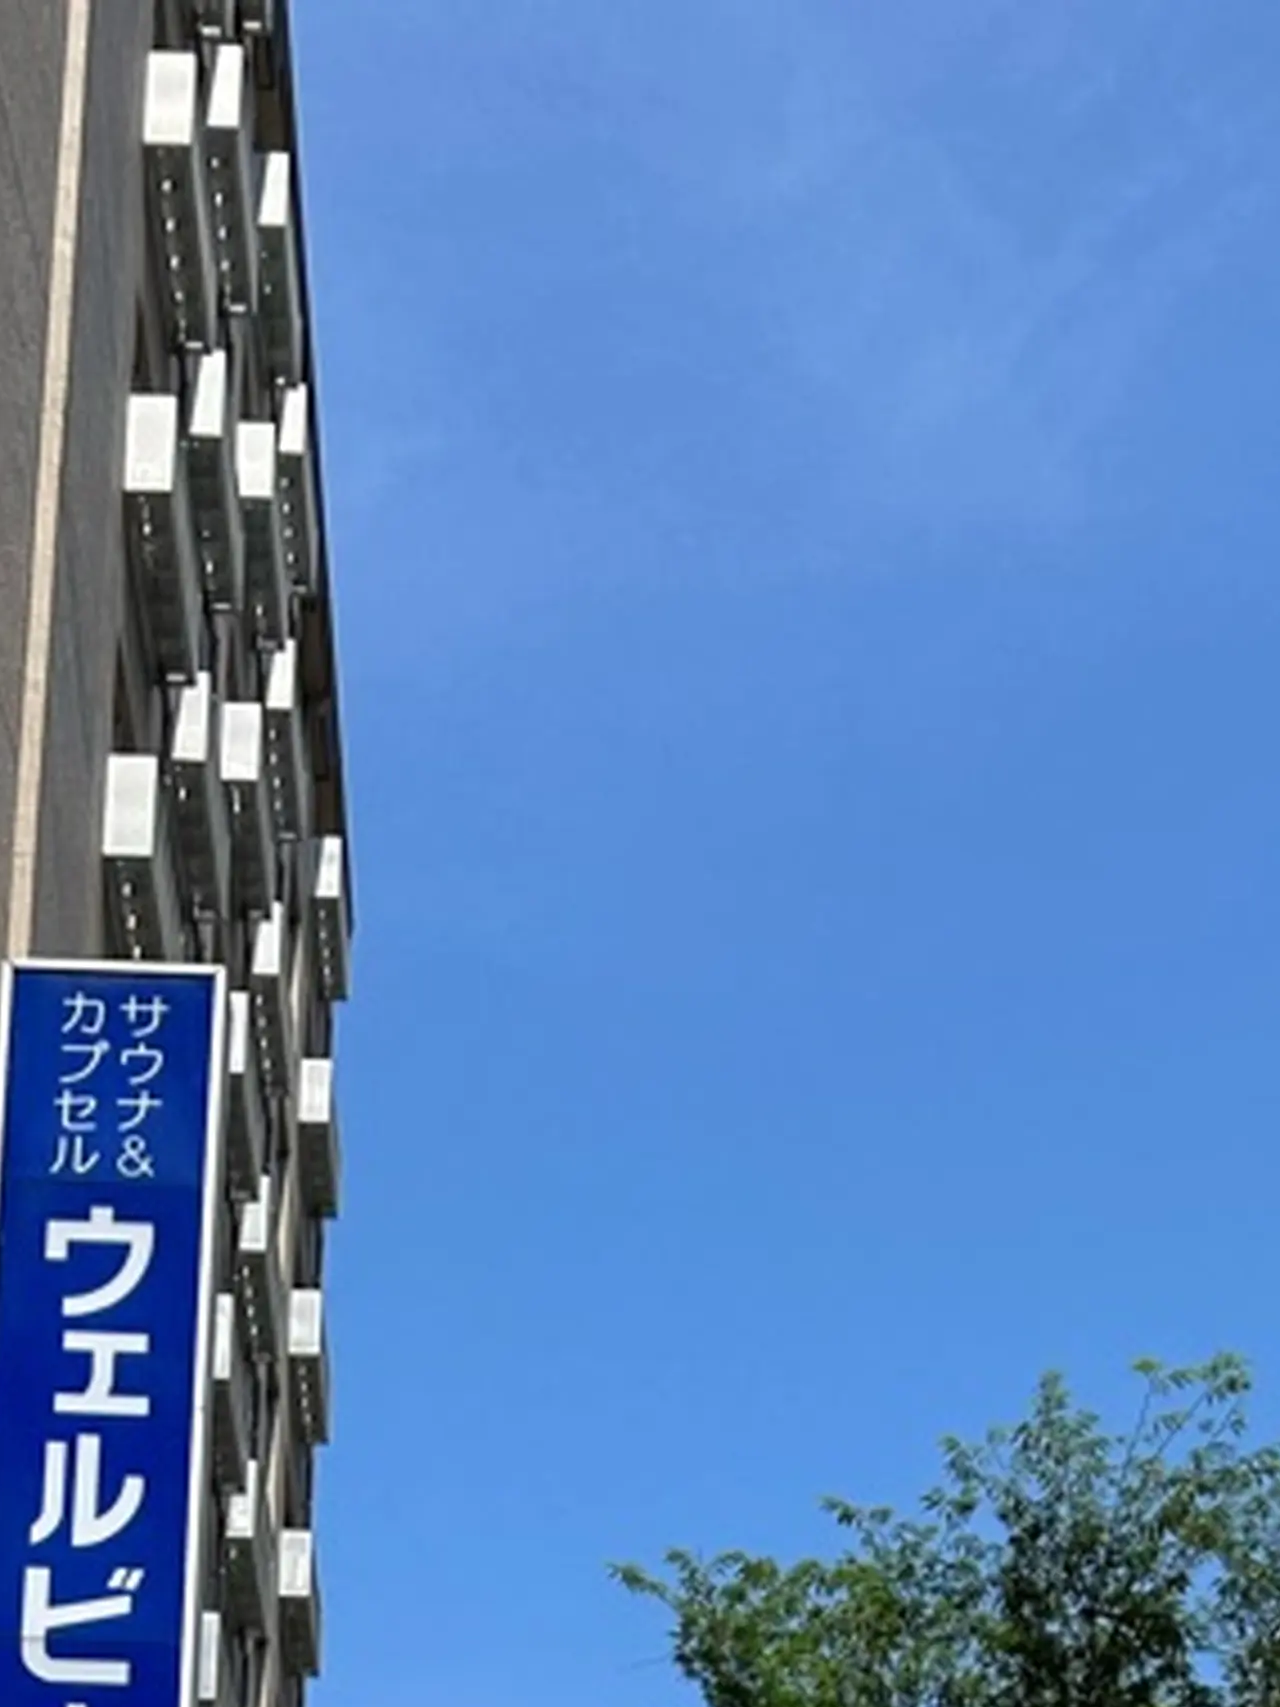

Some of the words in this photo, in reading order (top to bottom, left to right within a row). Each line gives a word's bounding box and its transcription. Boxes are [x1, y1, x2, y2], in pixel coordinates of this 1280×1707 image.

[48, 991, 109, 1175] カプセル
[117, 994, 170, 1179] サウナ&
